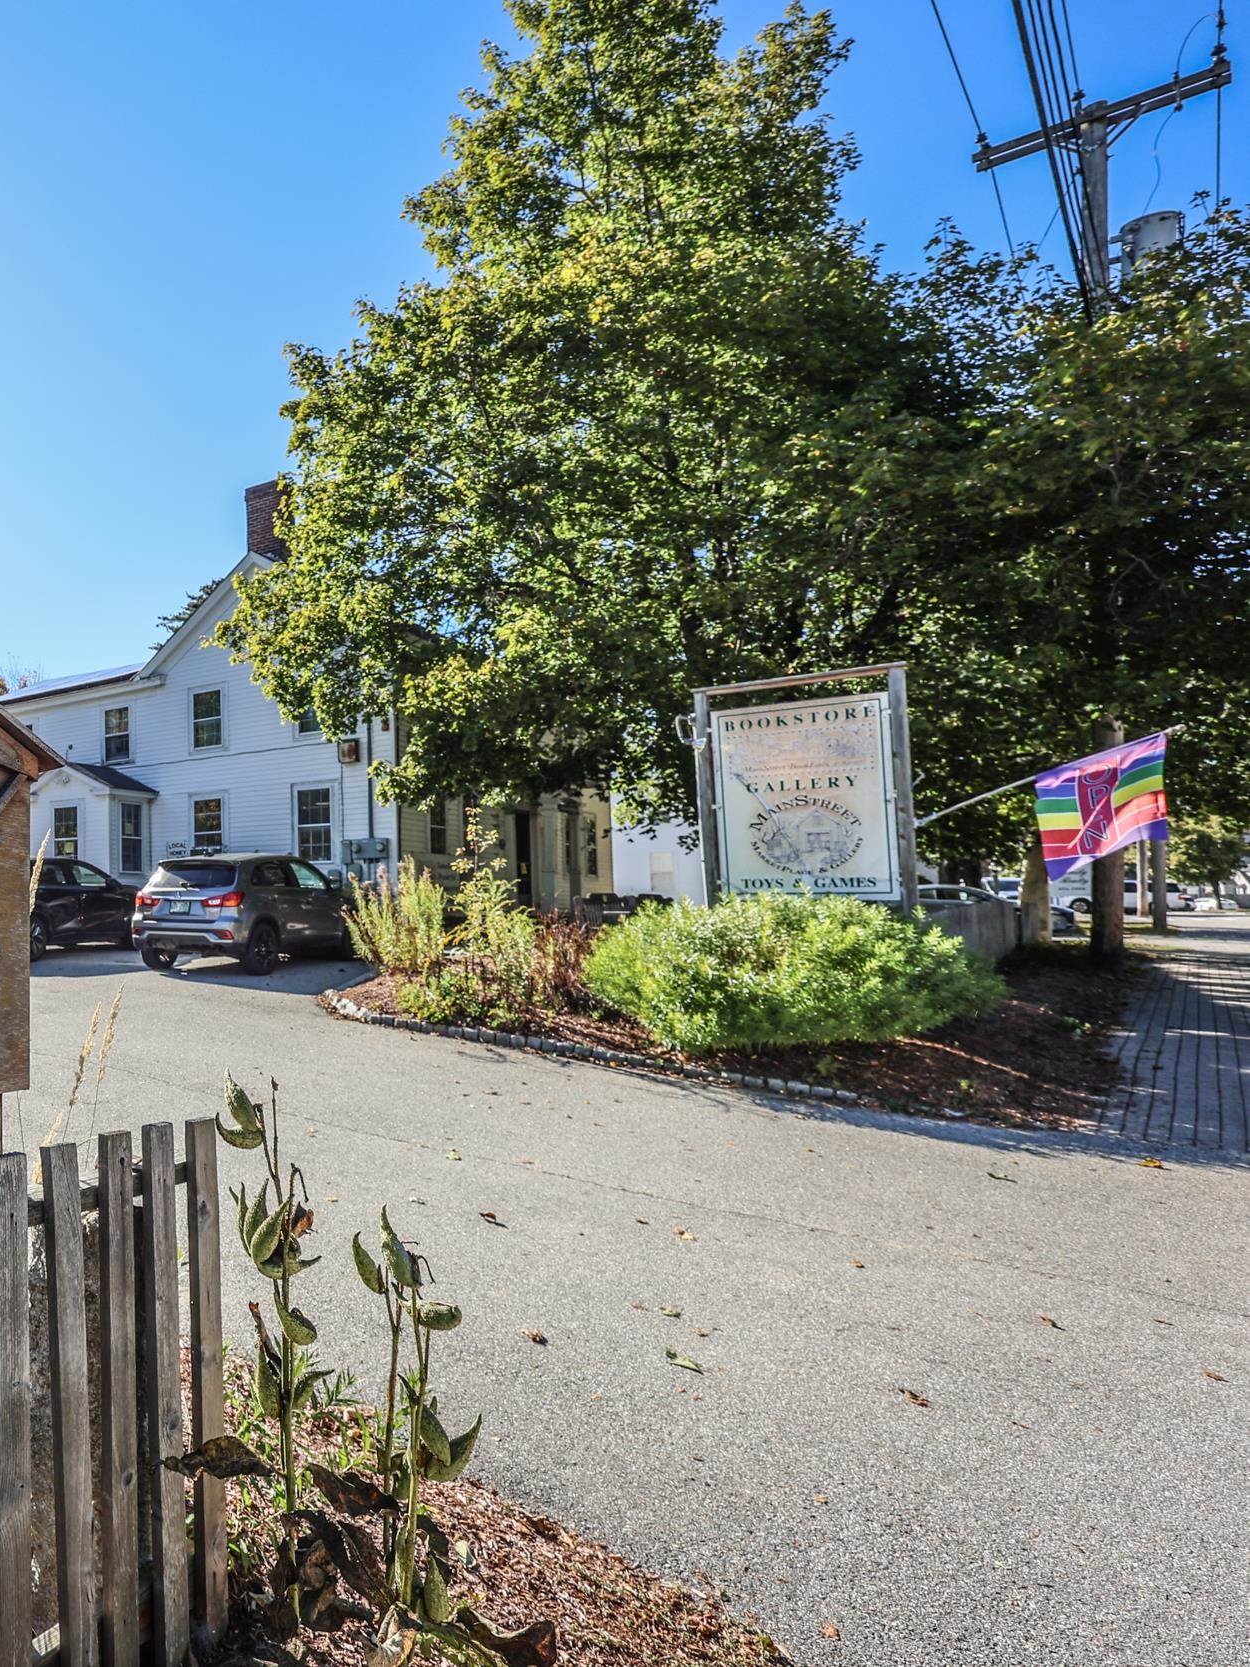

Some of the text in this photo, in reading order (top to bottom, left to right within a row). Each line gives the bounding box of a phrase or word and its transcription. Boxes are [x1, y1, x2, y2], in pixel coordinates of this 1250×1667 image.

[725, 705, 877, 732] BOOKSTORE
[746, 775, 858, 793] GALLERY
[1082, 765, 1112, 849] OPN
[741, 877, 877, 889] TOYS & GAMES
